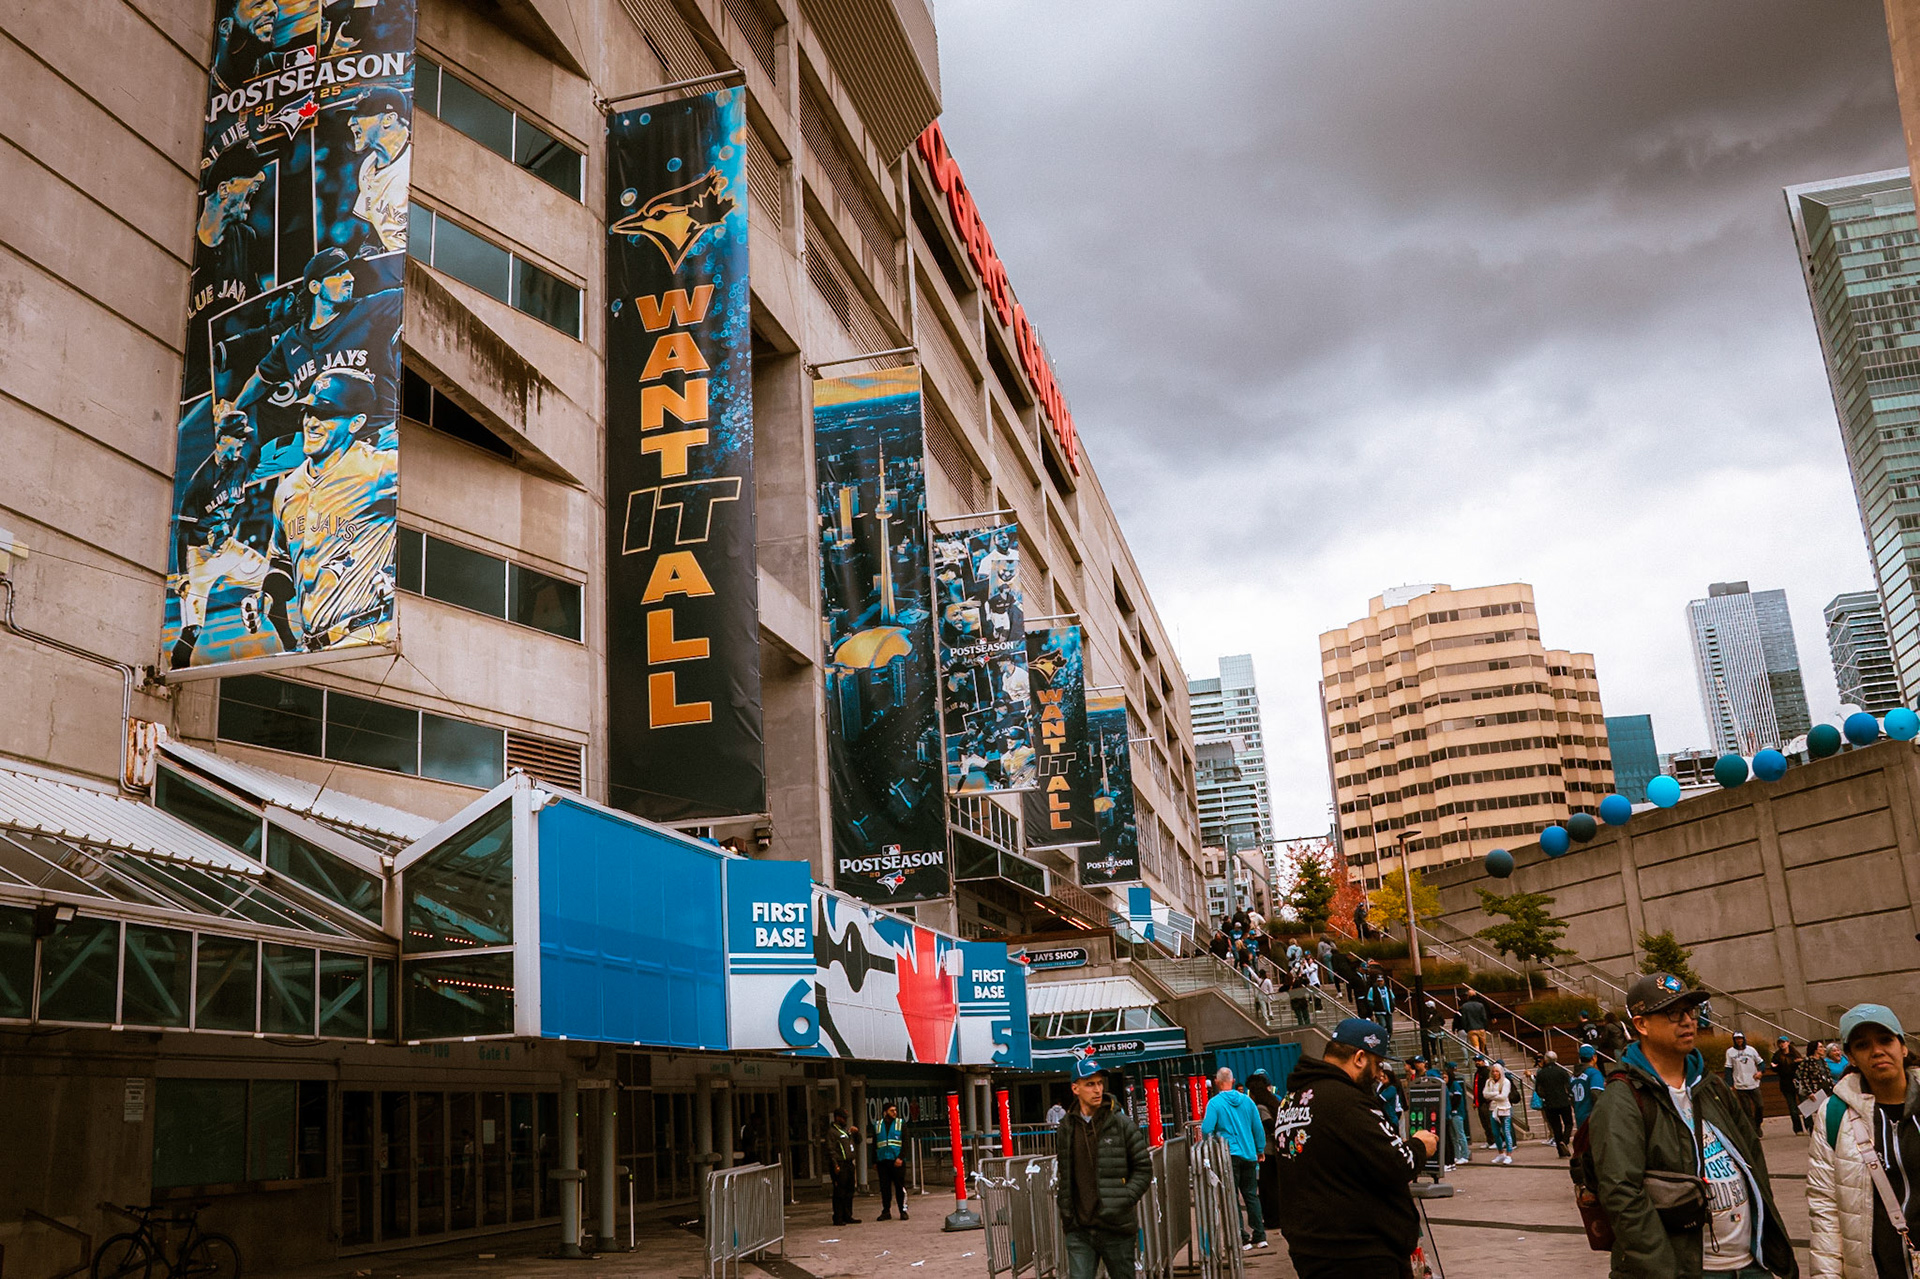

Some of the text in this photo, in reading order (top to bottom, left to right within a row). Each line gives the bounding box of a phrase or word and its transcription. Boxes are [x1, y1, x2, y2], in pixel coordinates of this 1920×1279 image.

[210, 52, 405, 123] POSTSEASON
[254, 85, 342, 117] 20 25
[917, 118, 1011, 327] OGERS
[187, 283, 214, 319] LUE
[294, 350, 368, 393] LUE JAYS
[622, 284, 742, 729] WANT IT ALL
[310, 512, 357, 541] JAYS
[950, 641, 1014, 657] POSTSEASON
[1036, 688, 1077, 830] WANT IT ALL
[840, 851, 944, 874] POSTSEASON
[1086, 859, 1134, 870] POSTSEASON
[752, 902, 808, 923] FIRST
[755, 927, 807, 948] BASE
[1033, 951, 1079, 962] JAYS SHOP
[972, 969, 1006, 983] FIRST
[974, 985, 1005, 999] BASE
[778, 978, 820, 1047] 6
[991, 1020, 1013, 1064] 5
[1098, 1042, 1138, 1052] JAYS SHOP
[1571, 1083, 1585, 1102] 10
